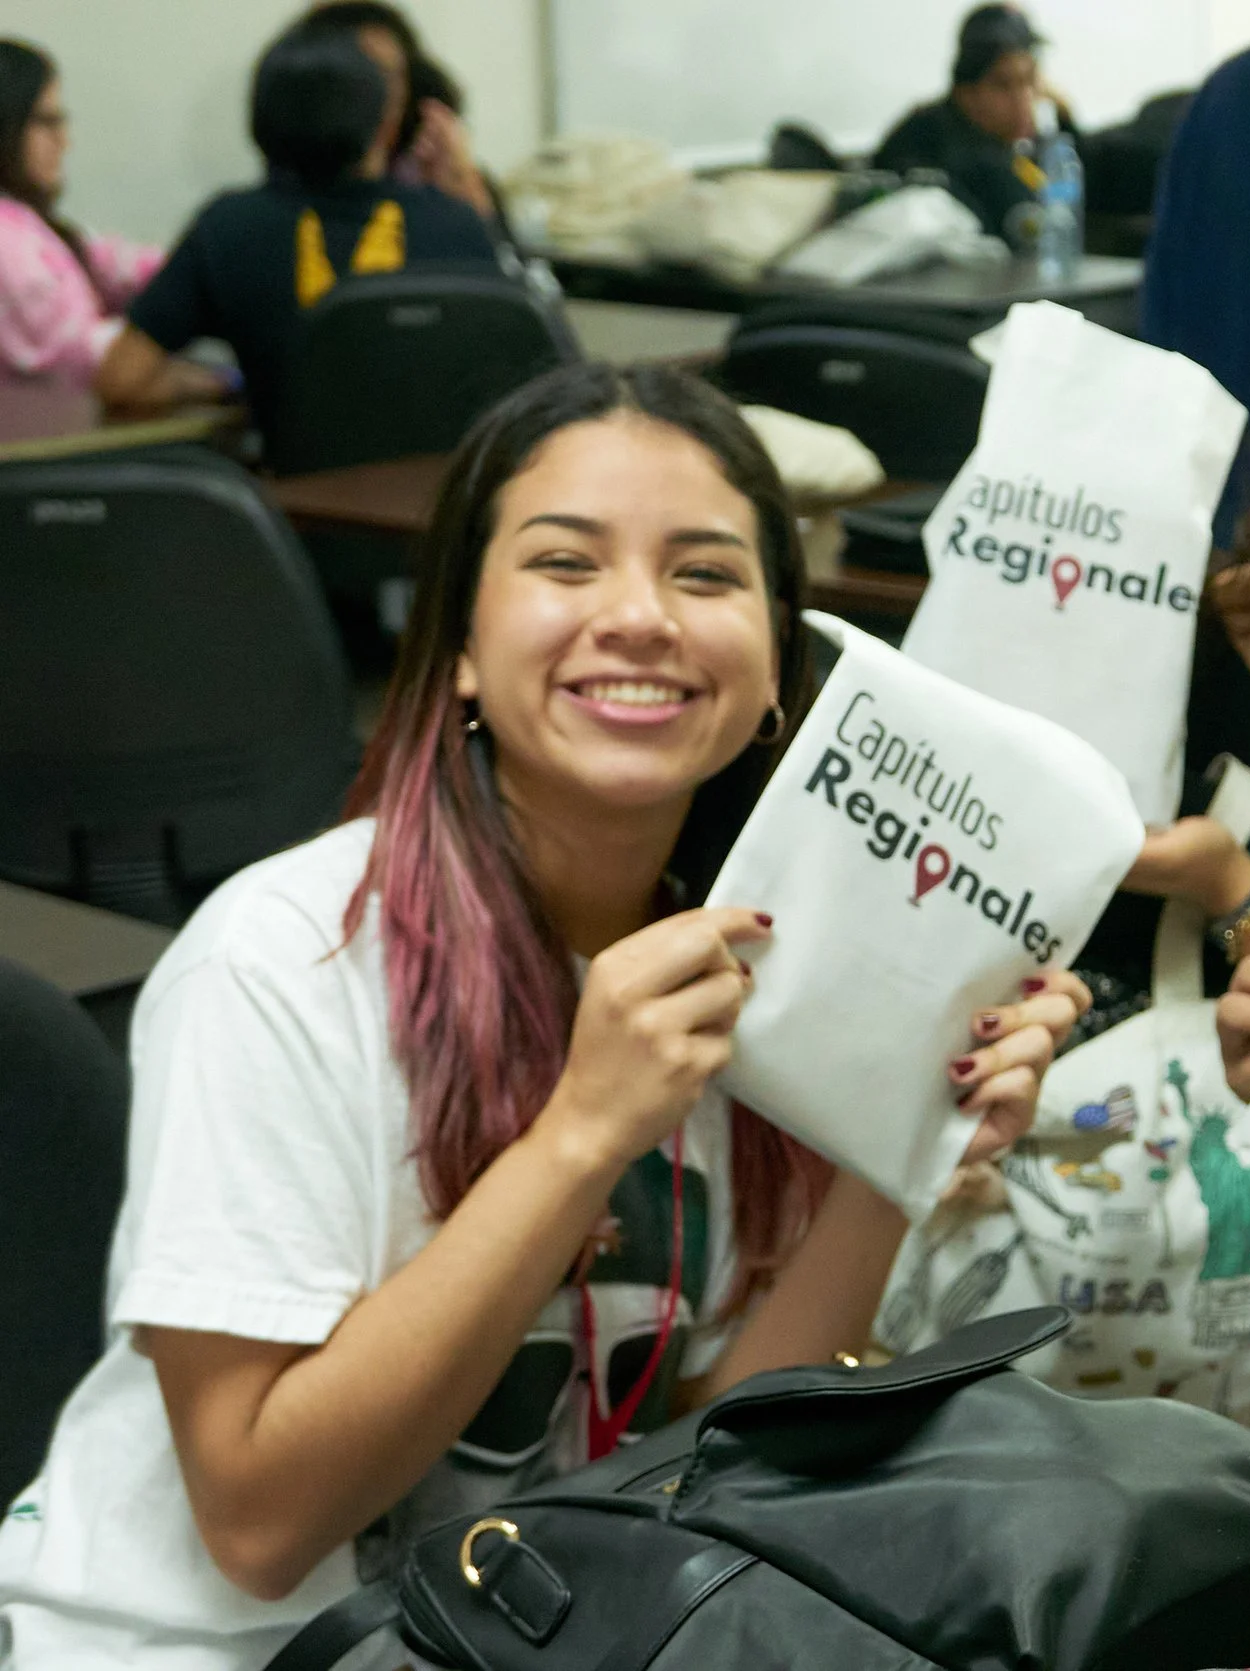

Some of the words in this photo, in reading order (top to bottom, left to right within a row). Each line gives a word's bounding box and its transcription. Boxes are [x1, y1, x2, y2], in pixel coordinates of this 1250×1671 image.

[946, 515, 1198, 612] Regionale
[966, 473, 1127, 544] apítulos
[836, 690, 1003, 850] Capítulos
[804, 747, 1062, 965] Regionales
